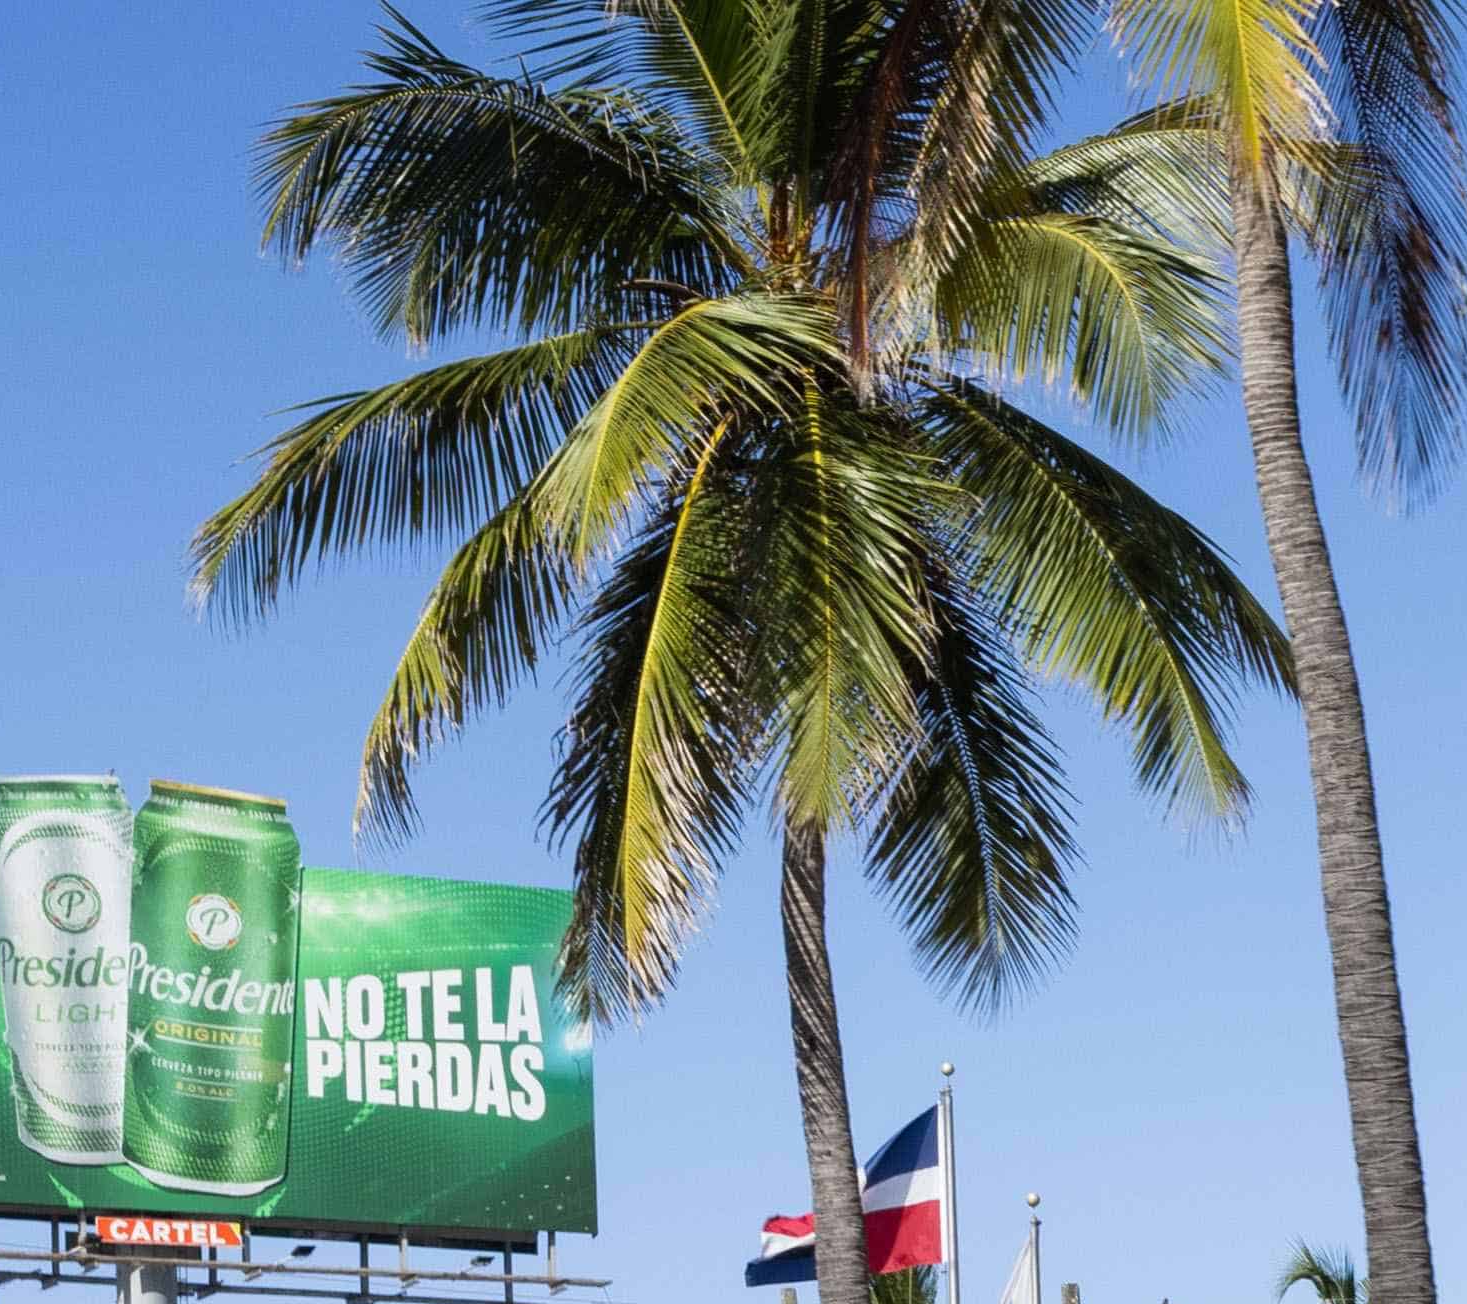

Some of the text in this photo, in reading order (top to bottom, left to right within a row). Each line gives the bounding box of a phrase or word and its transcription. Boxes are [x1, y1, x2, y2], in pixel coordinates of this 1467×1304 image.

[304, 965, 543, 1042] NO TE LA
[154, 1019, 262, 1048] ORIGINAL
[306, 1039, 546, 1121] PIERDAS
[109, 1219, 227, 1245] CARTEL
